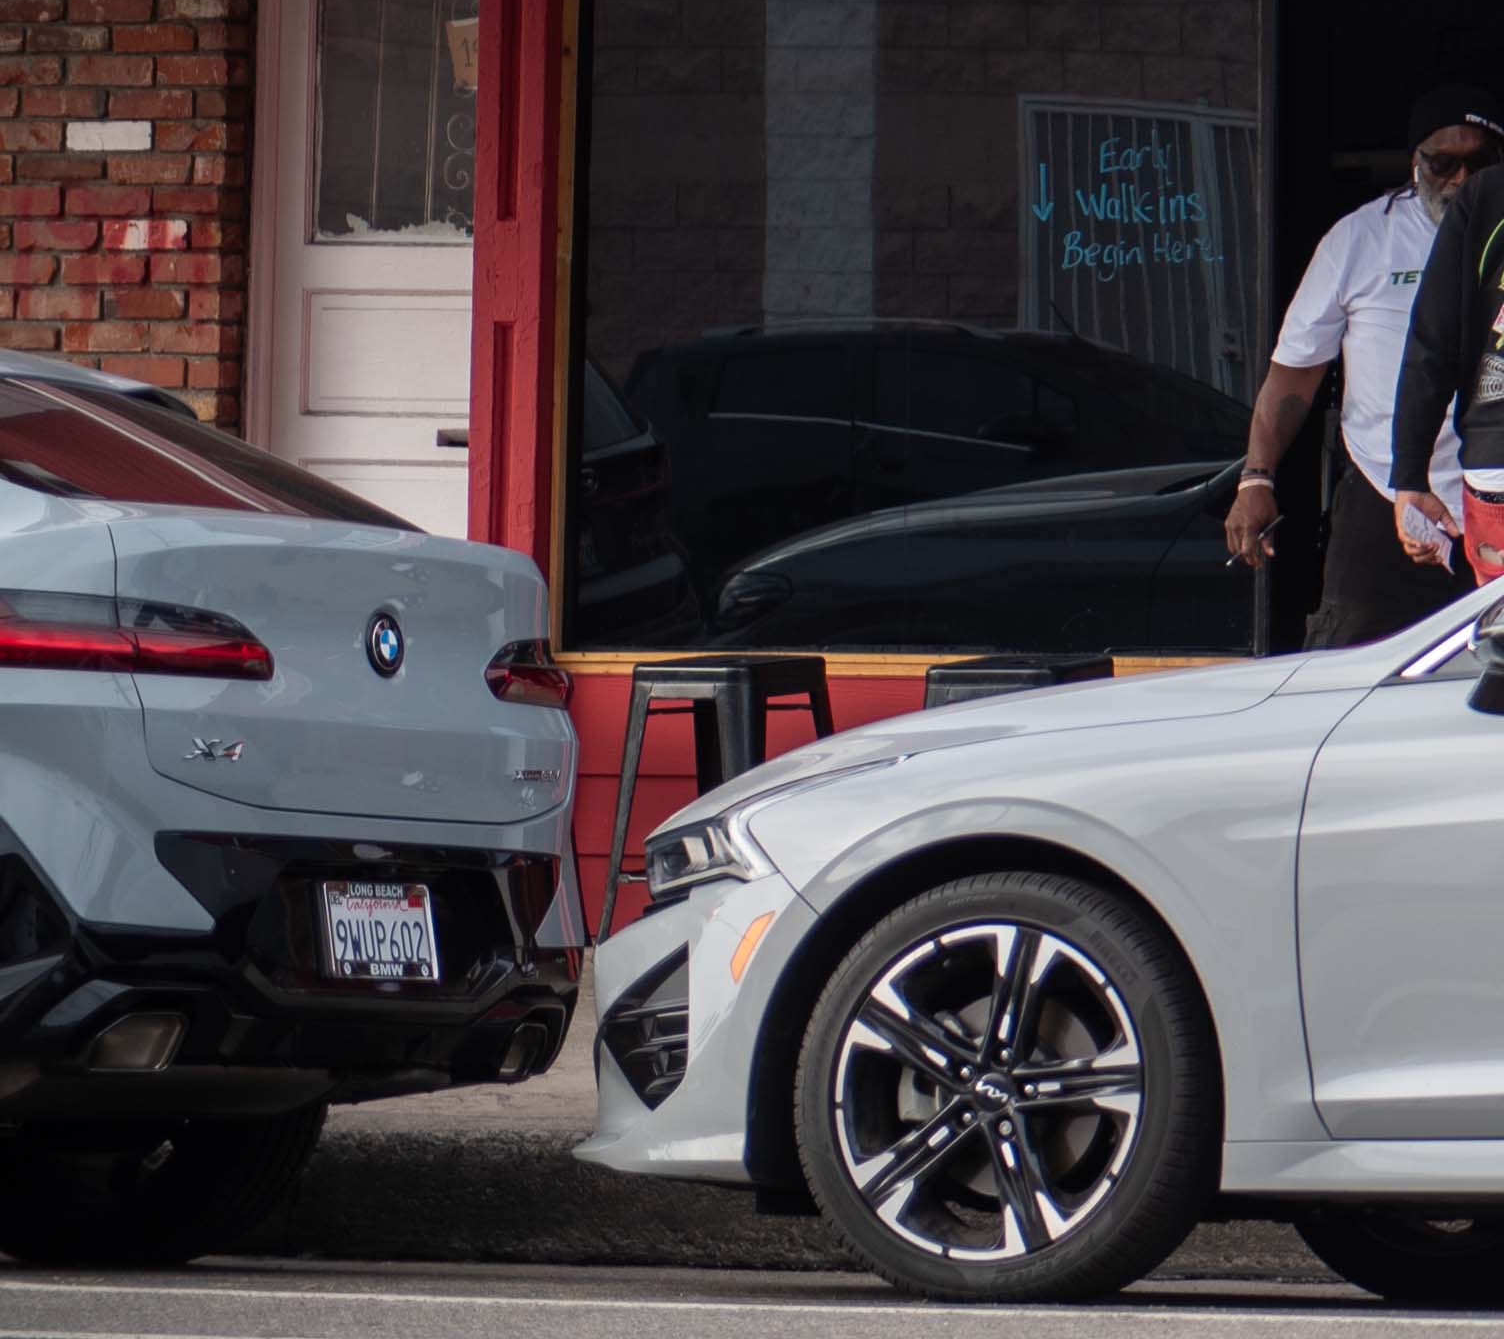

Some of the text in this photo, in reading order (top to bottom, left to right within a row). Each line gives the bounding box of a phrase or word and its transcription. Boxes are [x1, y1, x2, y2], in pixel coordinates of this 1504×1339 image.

[1061, 230, 1143, 282] Begin
[350, 884, 404, 899] LONG BEACH
[335, 918, 428, 964] 9WUP602
[370, 963, 404, 977] BMW
